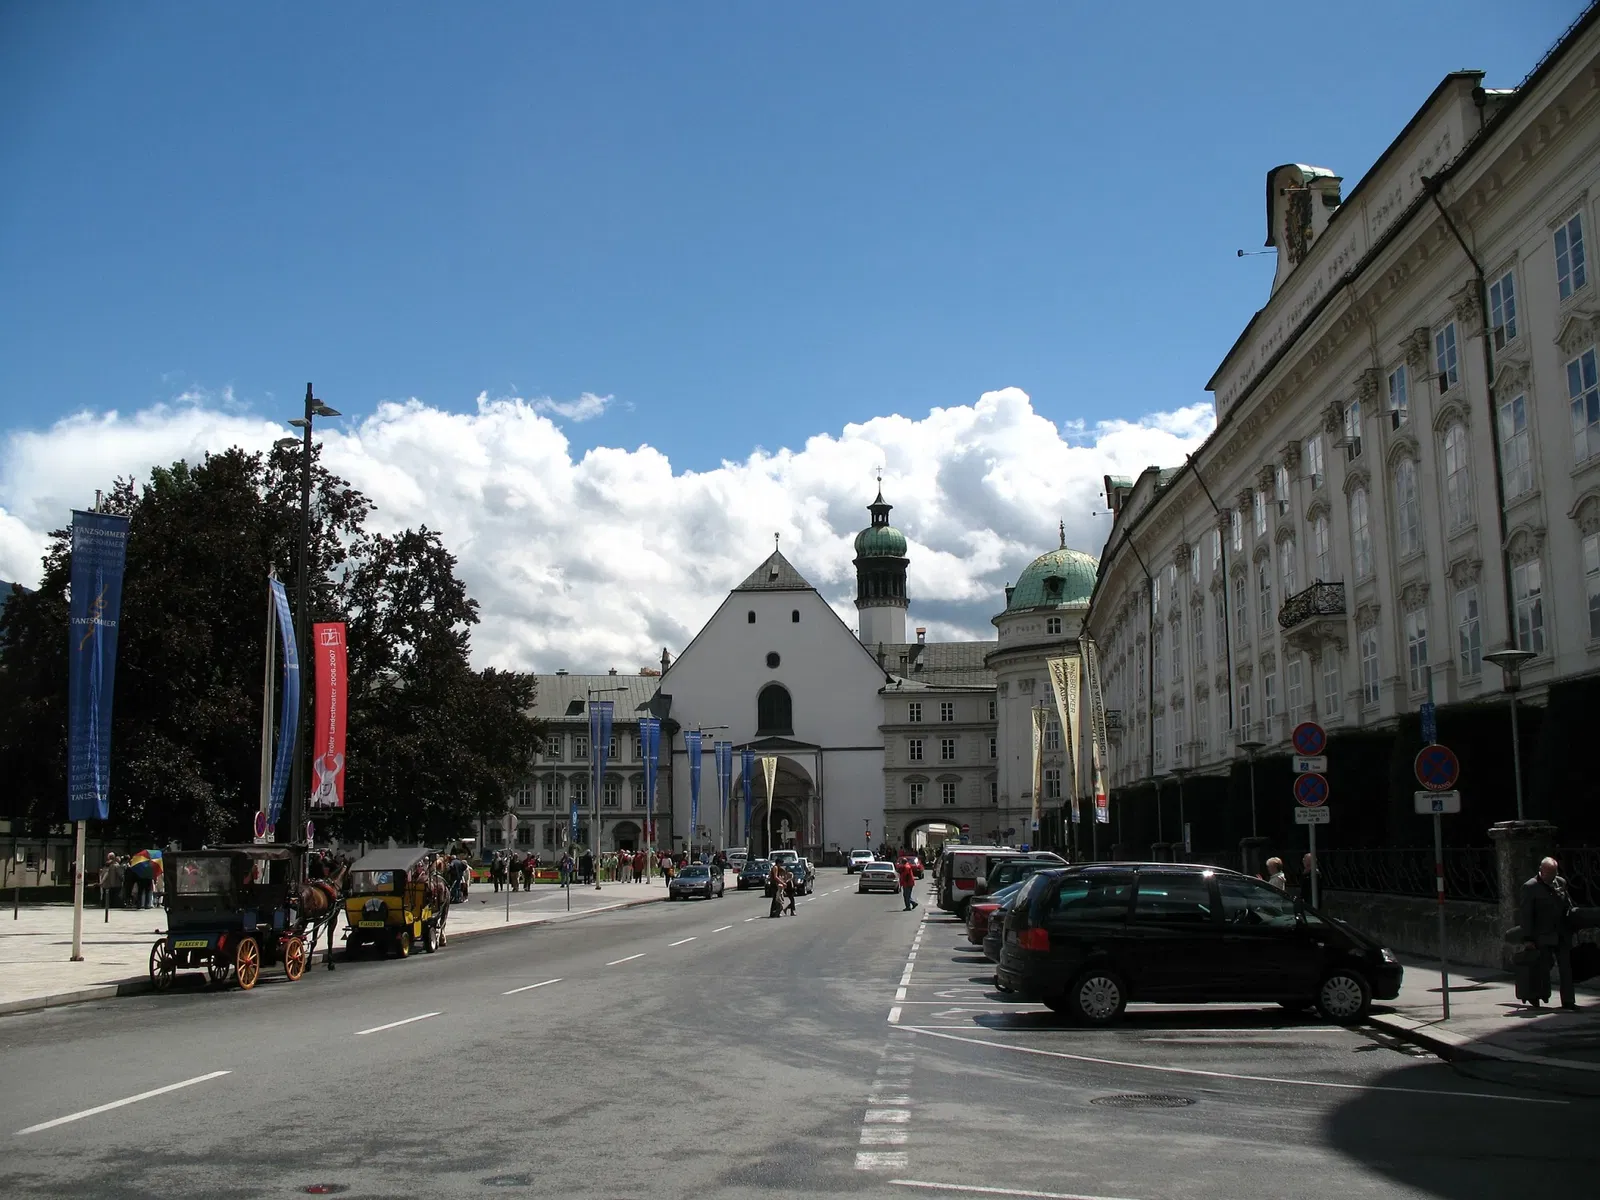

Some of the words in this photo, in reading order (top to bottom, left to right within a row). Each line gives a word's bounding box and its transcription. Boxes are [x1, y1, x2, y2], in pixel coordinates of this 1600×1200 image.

[75, 526, 126, 539] TANZSOMMER
[1069, 661, 1077, 714] INNSBRUCKER
[327, 736, 335, 757] Tiroler
